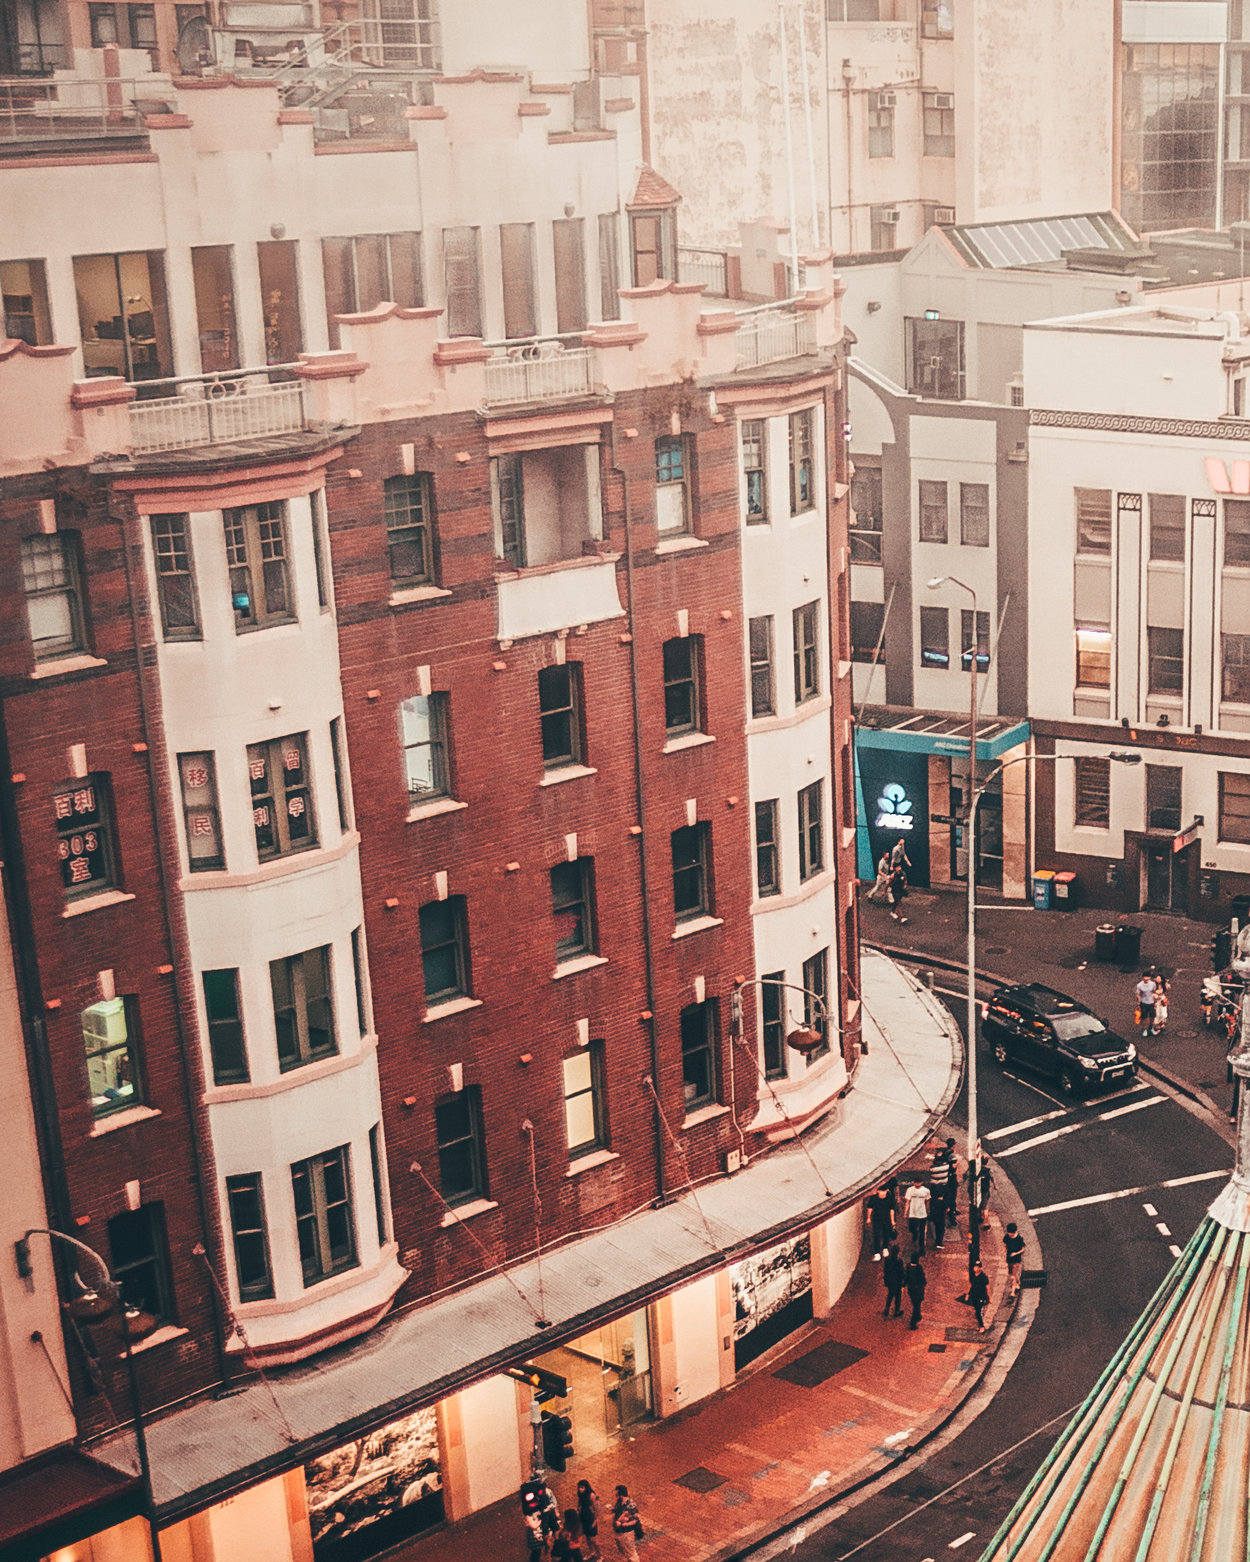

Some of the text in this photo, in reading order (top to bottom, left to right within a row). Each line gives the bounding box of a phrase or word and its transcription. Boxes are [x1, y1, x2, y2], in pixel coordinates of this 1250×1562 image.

[53, 787, 95, 819] 百利
[187, 768, 211, 836] 移民
[57, 831, 98, 859] 303
[69, 857, 92, 882] 室
